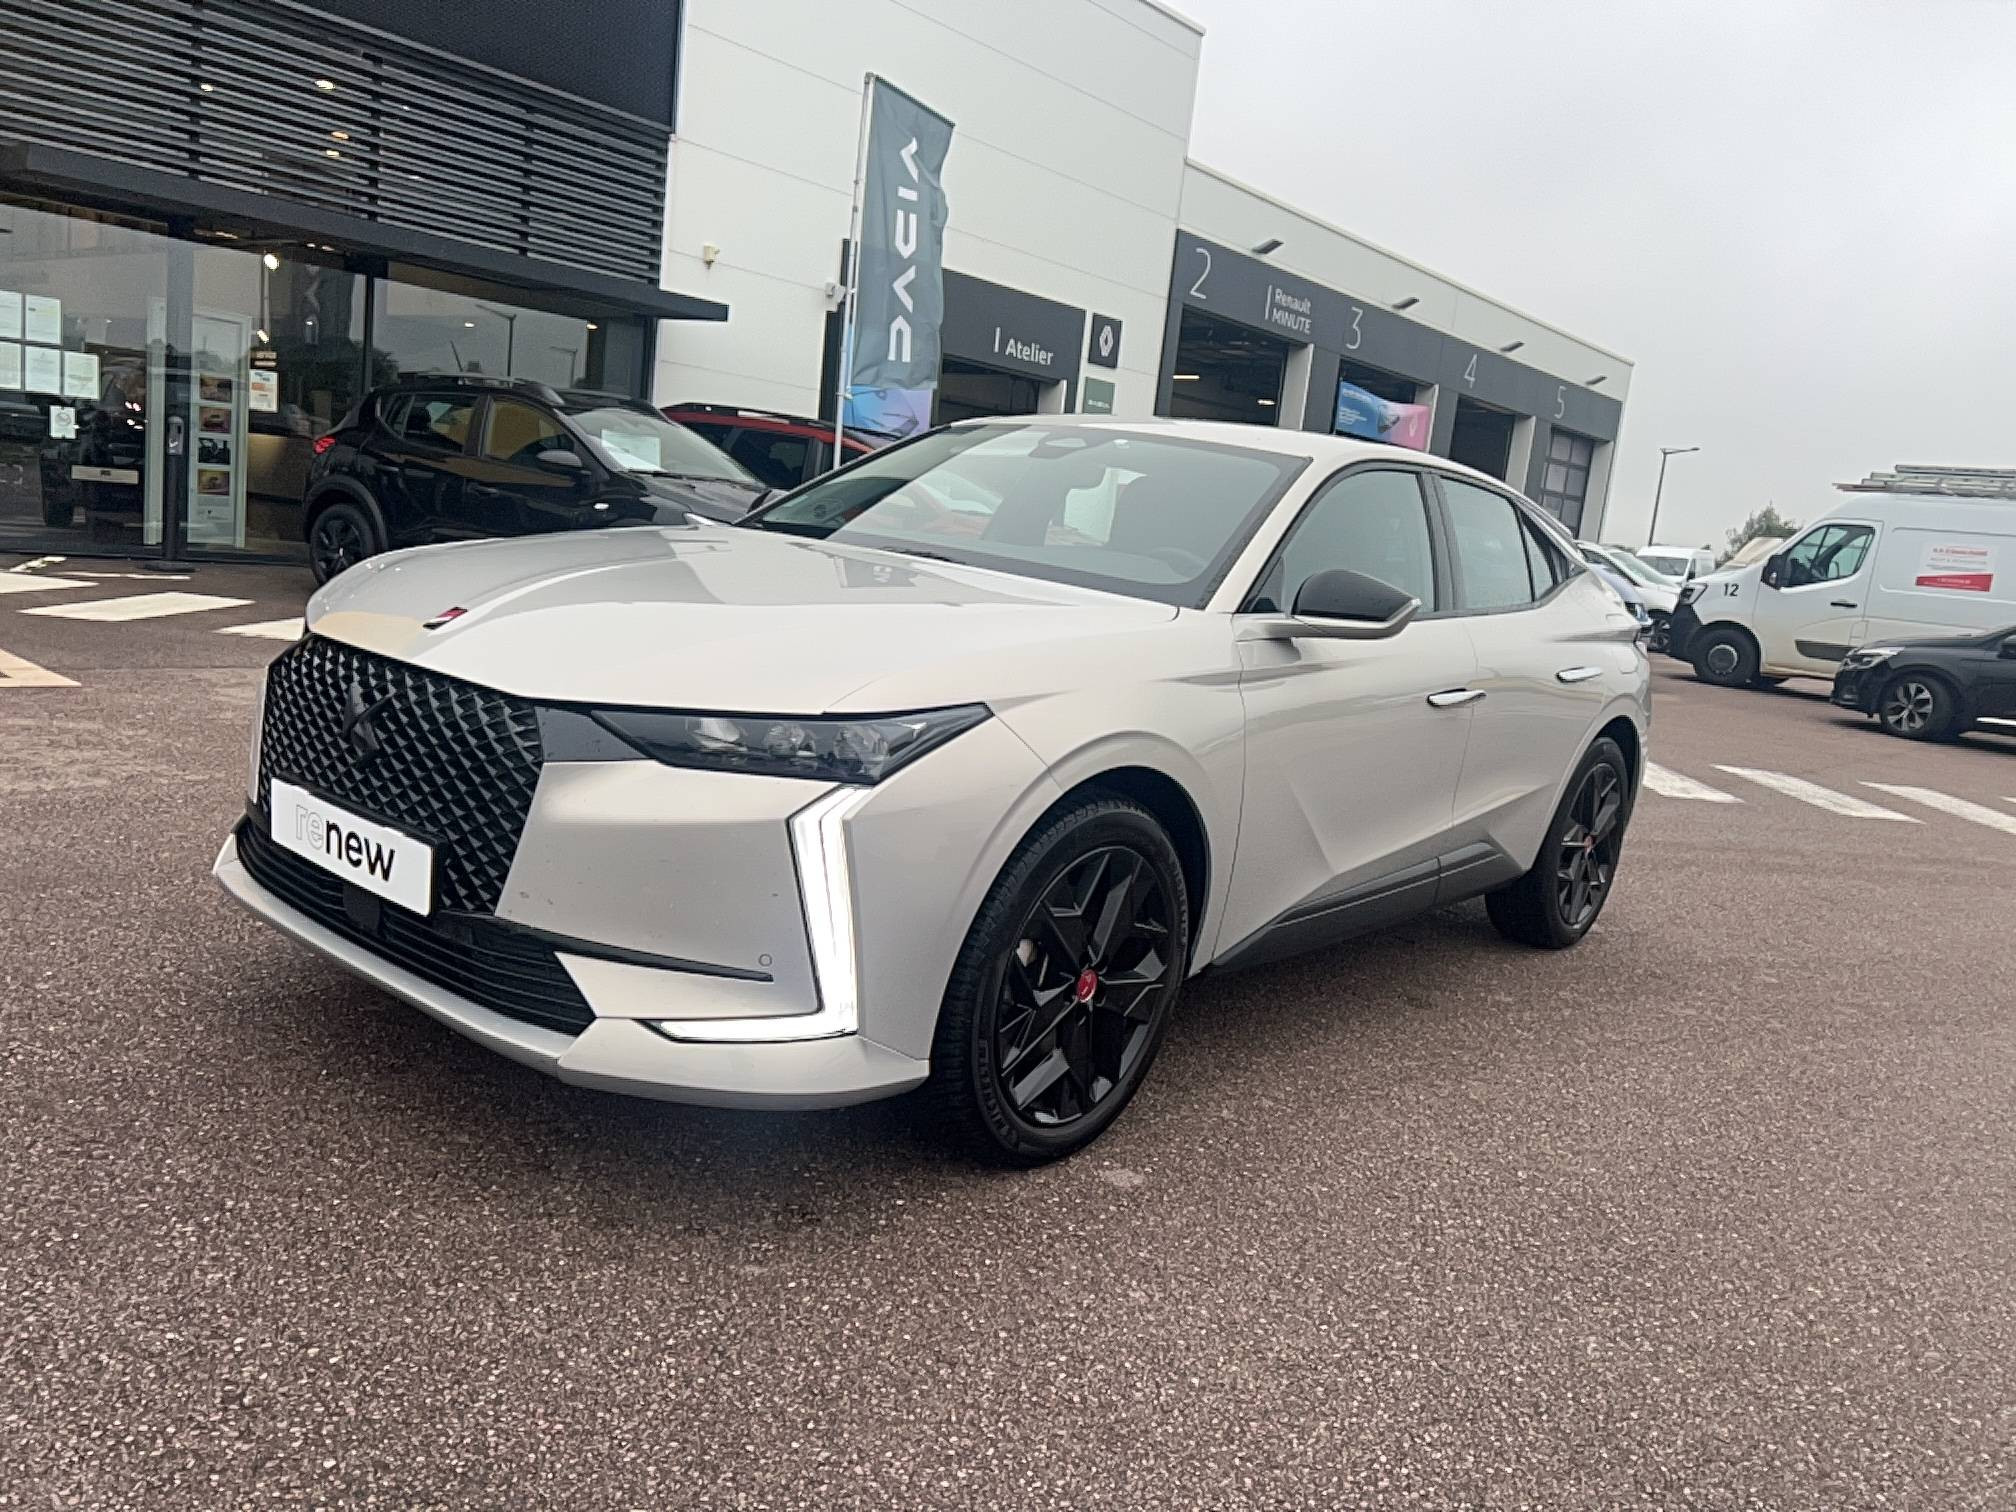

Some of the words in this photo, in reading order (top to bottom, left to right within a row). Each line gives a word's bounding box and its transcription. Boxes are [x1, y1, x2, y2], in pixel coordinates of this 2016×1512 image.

[887, 136, 919, 363] DACIA
[1190, 247, 1212, 299] 2
[1274, 288, 1311, 315] Renault
[1272, 307, 1312, 335] MINUTE
[1345, 306, 1364, 349] 3
[1005, 338, 1054, 366] Atelier
[1463, 352, 1478, 389] 4
[1554, 385, 1567, 419] 5
[1724, 582, 1740, 597] 12
[296, 804, 396, 882] renew
